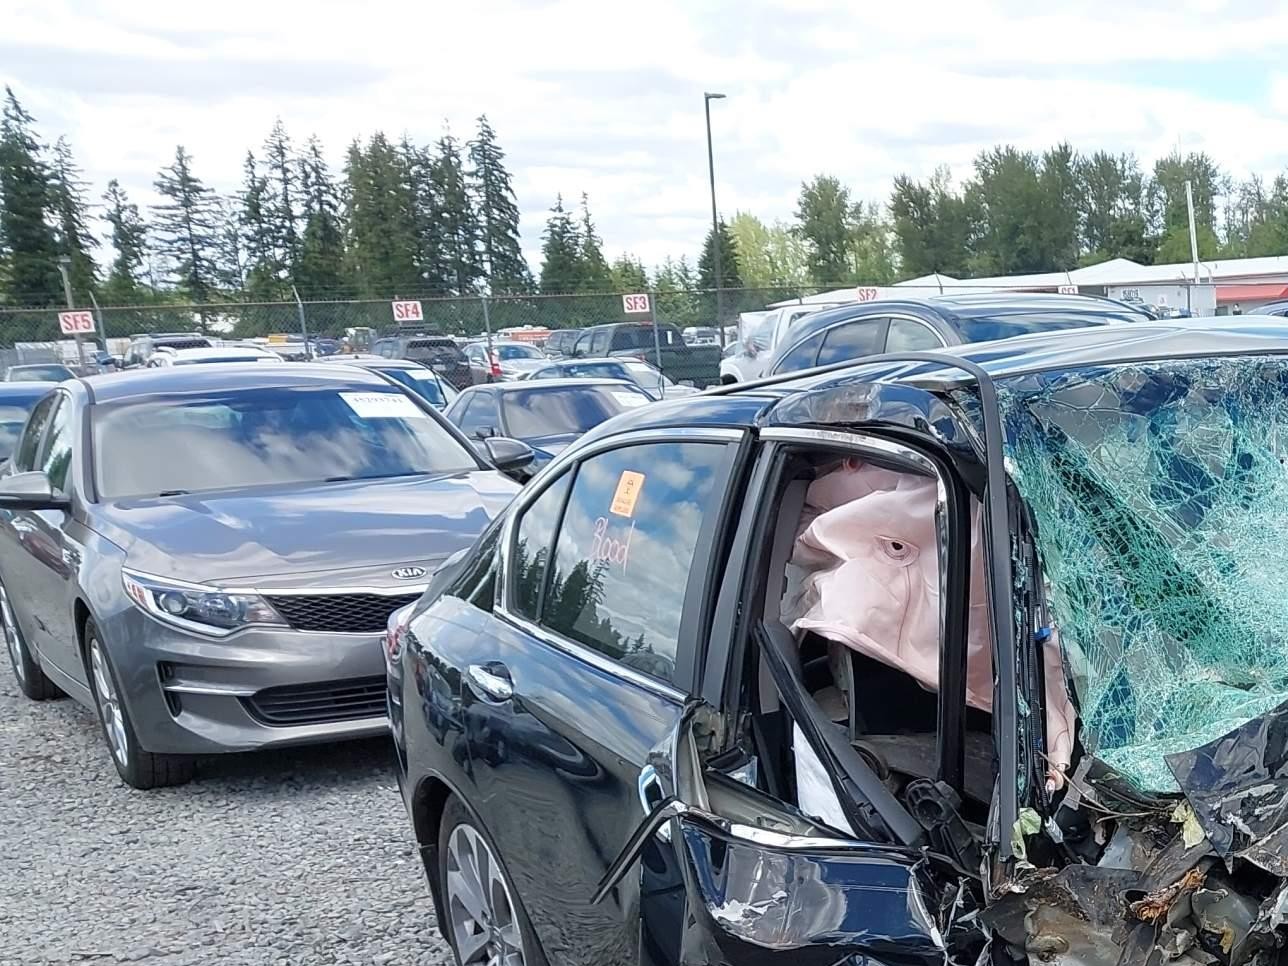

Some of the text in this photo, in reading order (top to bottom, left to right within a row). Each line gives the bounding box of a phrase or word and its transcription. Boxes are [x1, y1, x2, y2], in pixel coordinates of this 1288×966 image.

[395, 304, 420, 318] SF4
[625, 295, 647, 311] SF3
[63, 314, 92, 331] SF5
[589, 516, 635, 577] Blood
[396, 567, 423, 577] KIA
